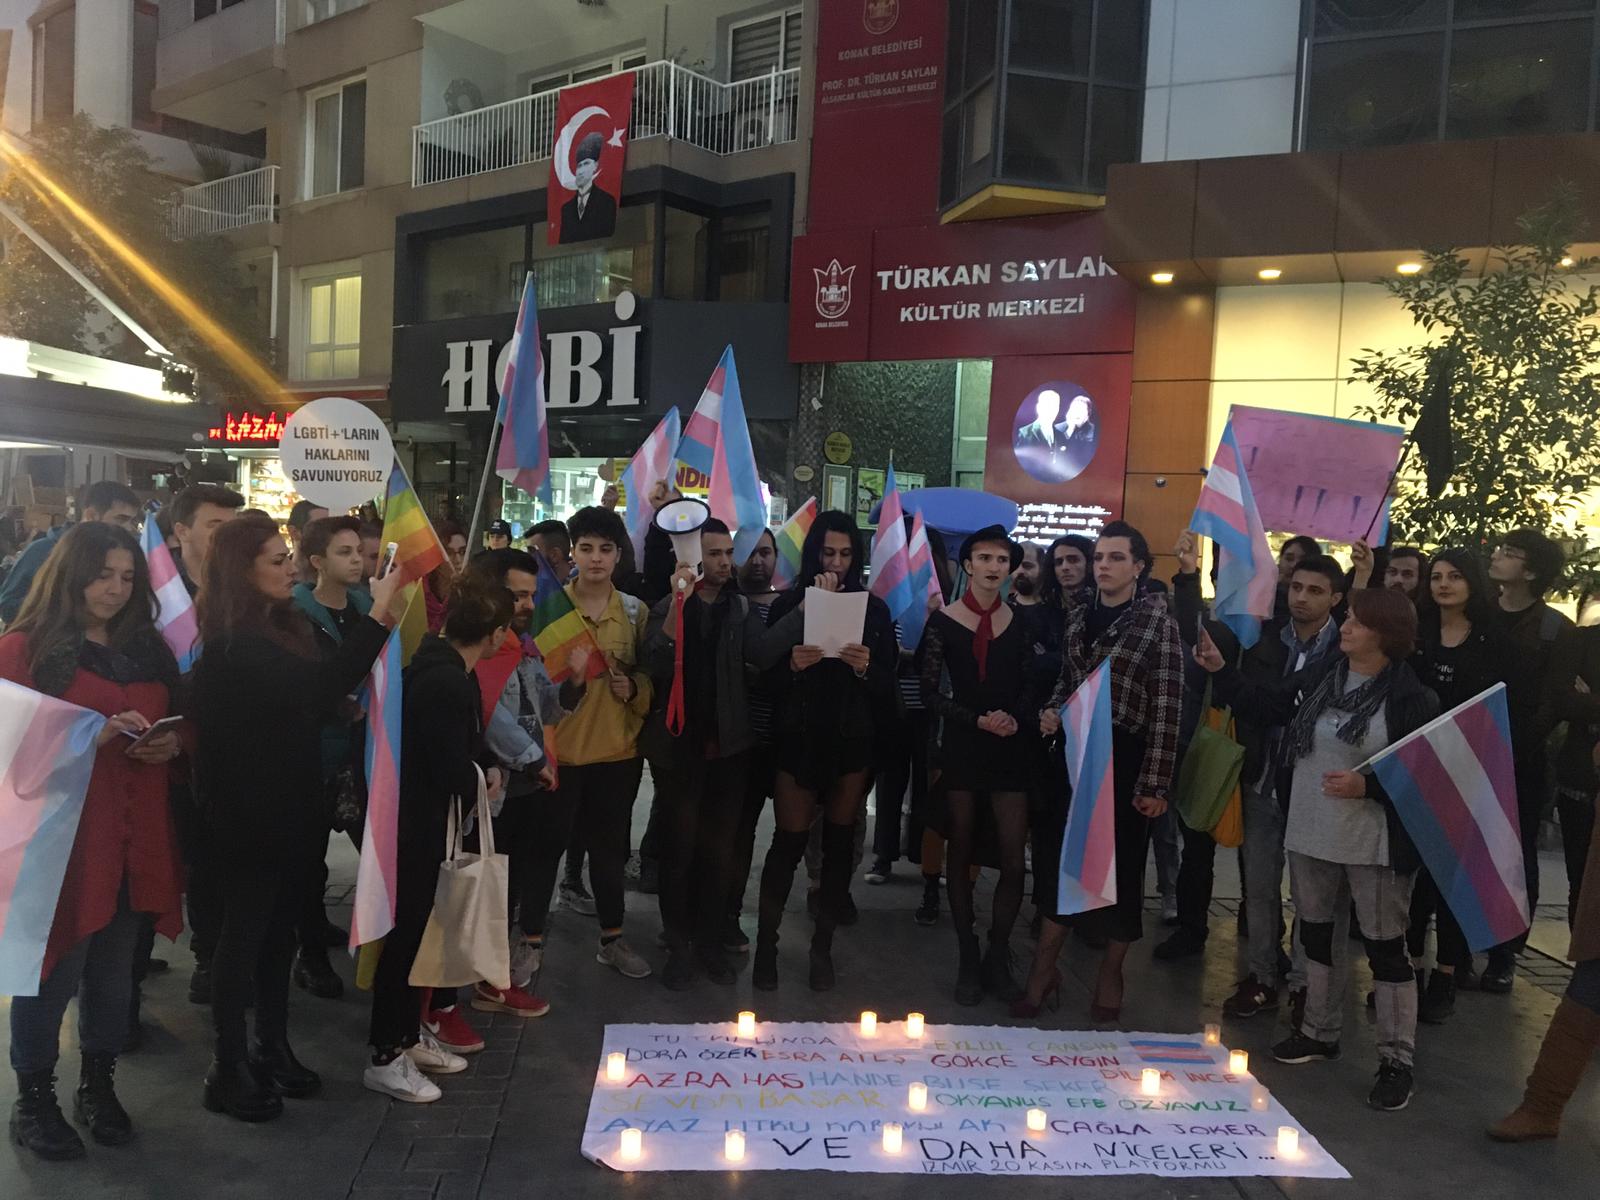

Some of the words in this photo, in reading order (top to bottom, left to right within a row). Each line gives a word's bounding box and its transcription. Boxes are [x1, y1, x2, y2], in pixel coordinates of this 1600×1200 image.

[877, 264, 991, 291] TÜRKAN
[900, 301, 981, 322] KÜLTÜR
[987, 293, 1085, 318] MERKEZİ
[305, 449, 370, 461] HAKLARINI
[292, 469, 383, 482] SAVUNUYORUZ
[625, 1047, 688, 1062] DORA
[698, 1047, 757, 1062] ÖZER
[1031, 1054, 1120, 1068] SAYGIN
[626, 1071, 732, 1089] AZRA
[743, 1072, 804, 1089] HAS
[808, 1071, 904, 1088] HANDE
[935, 1093, 1051, 1110] OKYANUS
[1067, 1097, 1107, 1110] EFE
[1168, 1122, 1267, 1138] JOKER
[772, 1136, 852, 1160] VE
[919, 1137, 1048, 1162] DAHA
[990, 1160, 1021, 1173] 20
[1028, 1160, 1093, 1171] KASIM
[1101, 1159, 1228, 1171] PLATFORMU
